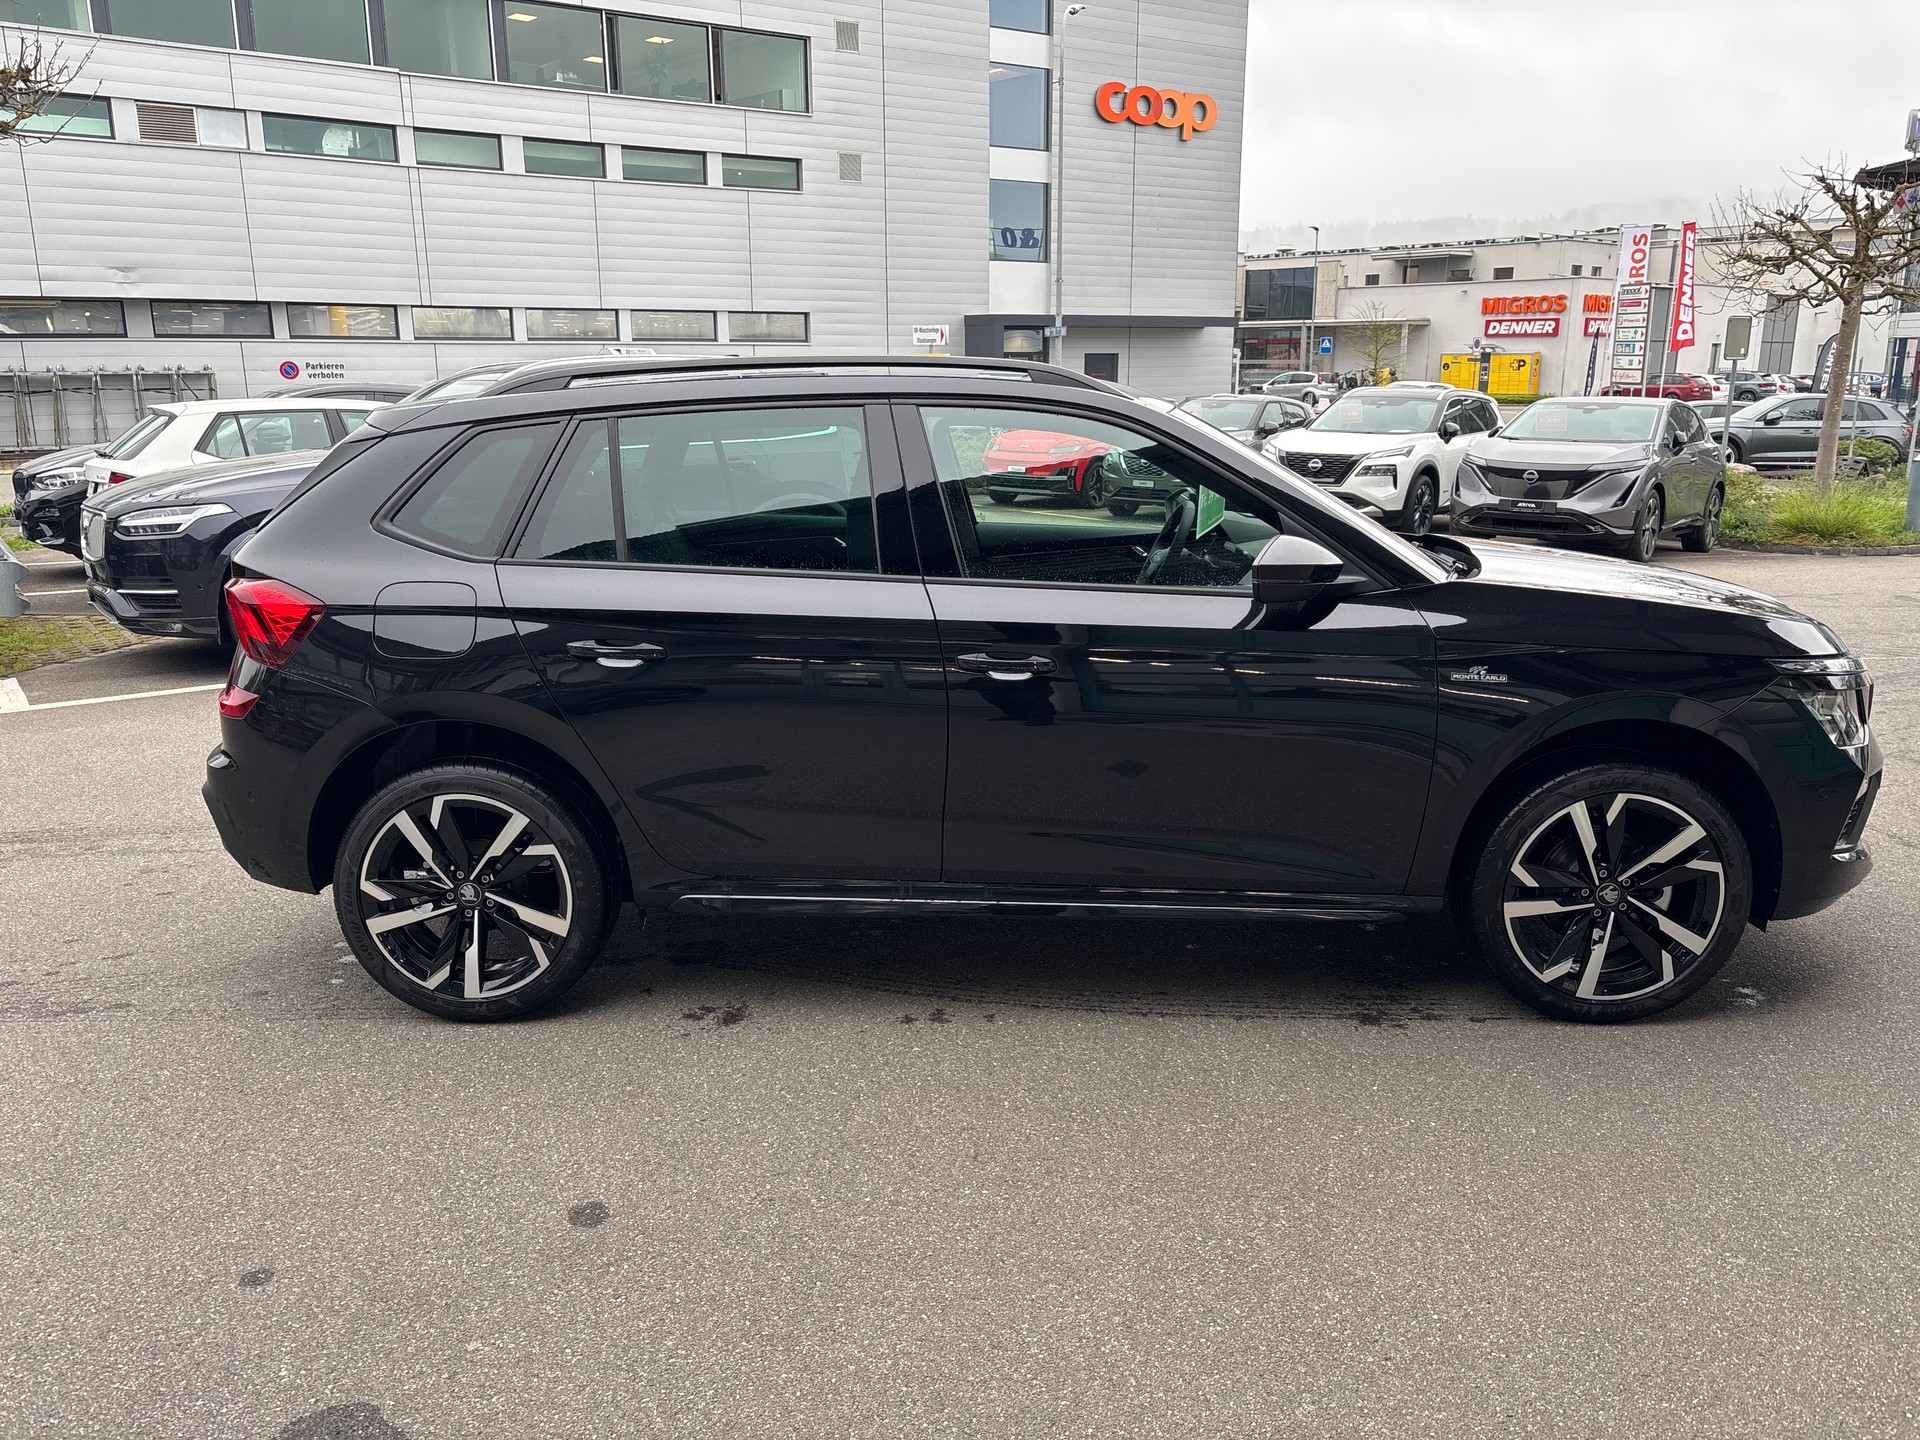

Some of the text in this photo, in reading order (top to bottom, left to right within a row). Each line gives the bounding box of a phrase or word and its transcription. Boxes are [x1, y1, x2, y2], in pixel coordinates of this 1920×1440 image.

[1096, 81, 1217, 141] coop
[1629, 232, 1649, 284] ROS
[1676, 229, 1695, 341] DENNER
[1481, 294, 1567, 315] MIGROS
[1487, 320, 1556, 335] DENNER
[305, 362, 345, 370] Parkieren
[307, 371, 345, 379] verboten
